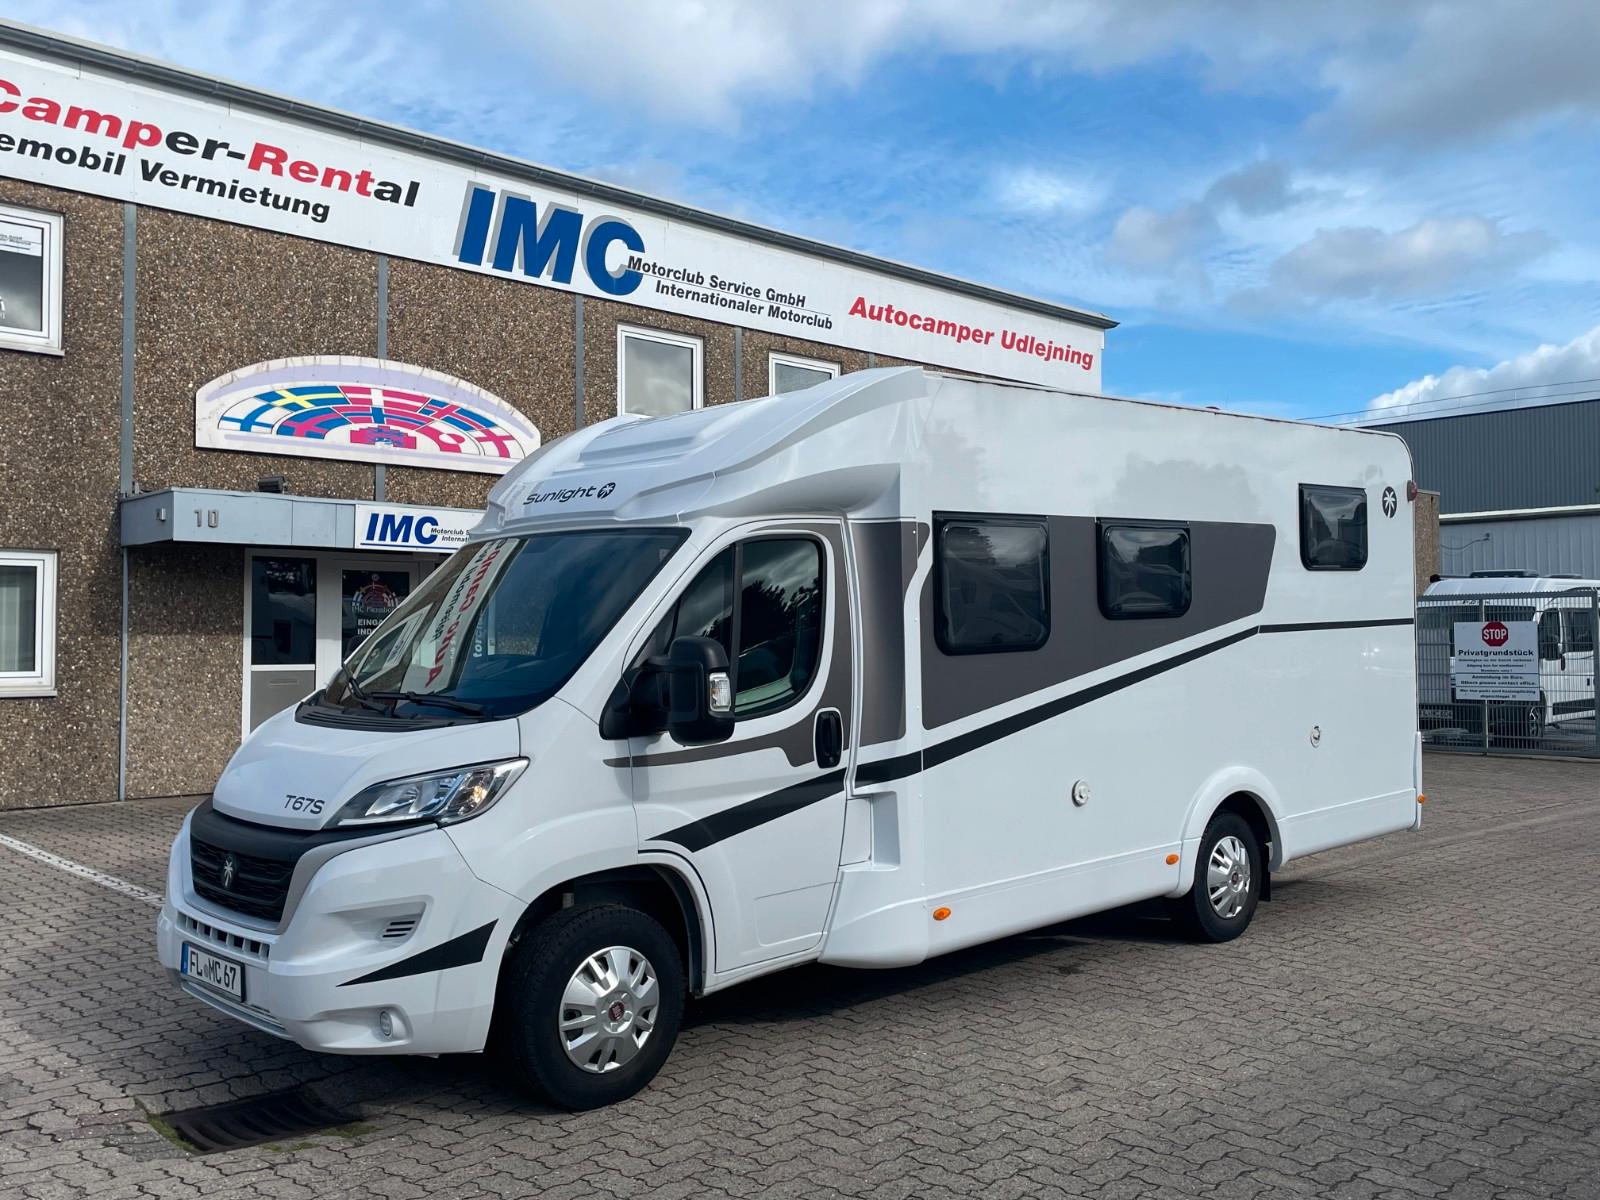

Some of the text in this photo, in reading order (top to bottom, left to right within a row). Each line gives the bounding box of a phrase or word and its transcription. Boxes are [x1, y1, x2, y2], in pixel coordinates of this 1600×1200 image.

[140, 158, 331, 223] Vermietung
[452, 180, 646, 297] IMC
[627, 254, 806, 308] Motorclub Service GmbH
[655, 279, 833, 331] Internationaler Motorclub
[848, 296, 1094, 371] Autocamper Udlejning
[194, 508, 219, 528] 10
[366, 513, 439, 545] IMC
[431, 527, 464, 535] Motorclub
[1483, 629, 1507, 640] STOP
[1458, 649, 1534, 657] Privatgrundstück
[284, 794, 325, 815] T67S
[190, 950, 237, 990] FL MC 67
